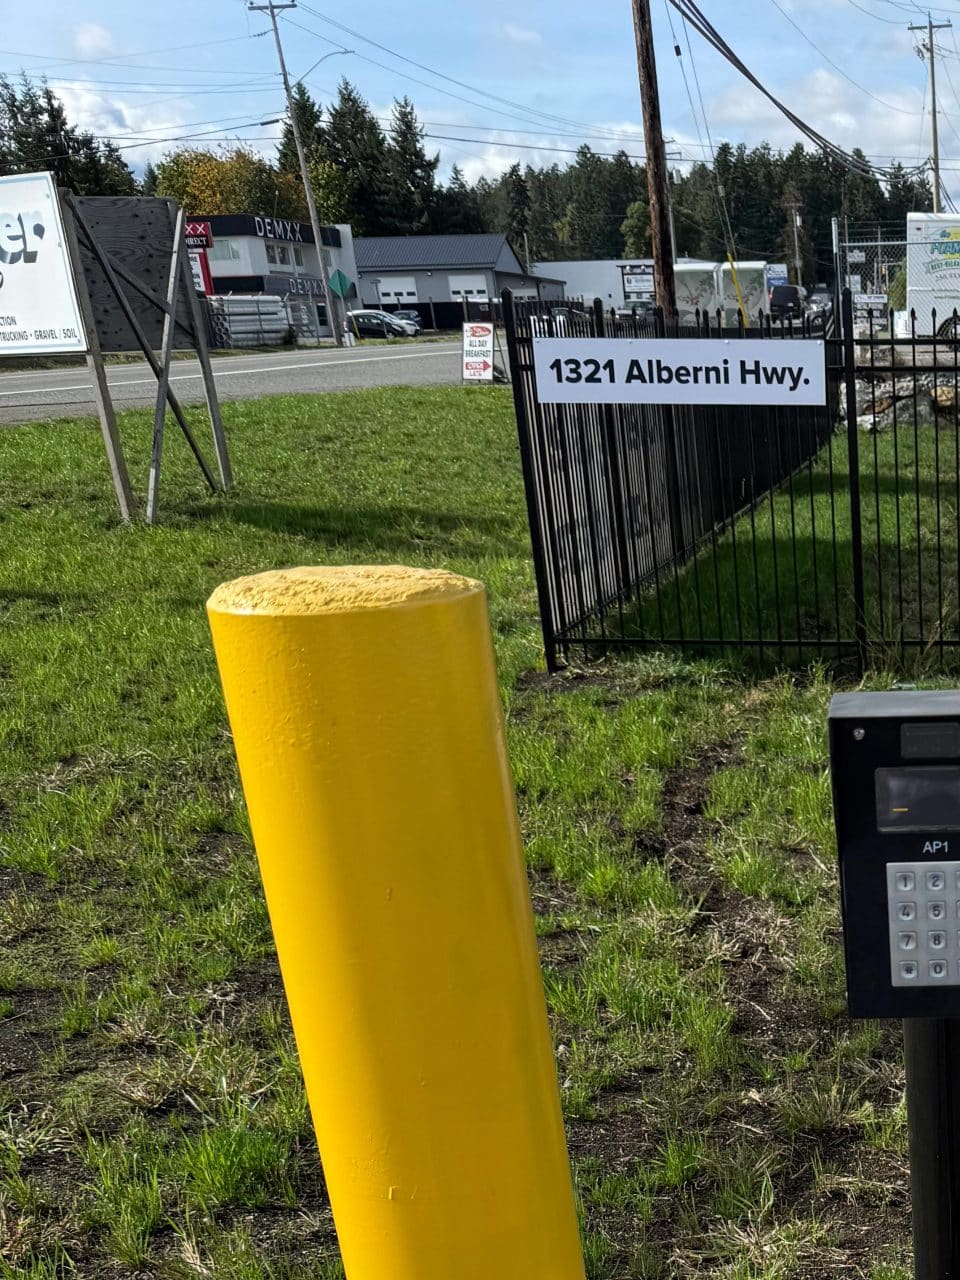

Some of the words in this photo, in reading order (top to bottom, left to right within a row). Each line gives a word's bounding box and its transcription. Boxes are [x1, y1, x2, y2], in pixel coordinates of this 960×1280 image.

[255, 216, 302, 241] DEMXX
[34, 329, 58, 340] GRAVEL
[550, 358, 616, 384] 1321
[625, 358, 730, 385] Alberni
[739, 360, 810, 392] Hwy.
[922, 841, 949, 853] AP1
